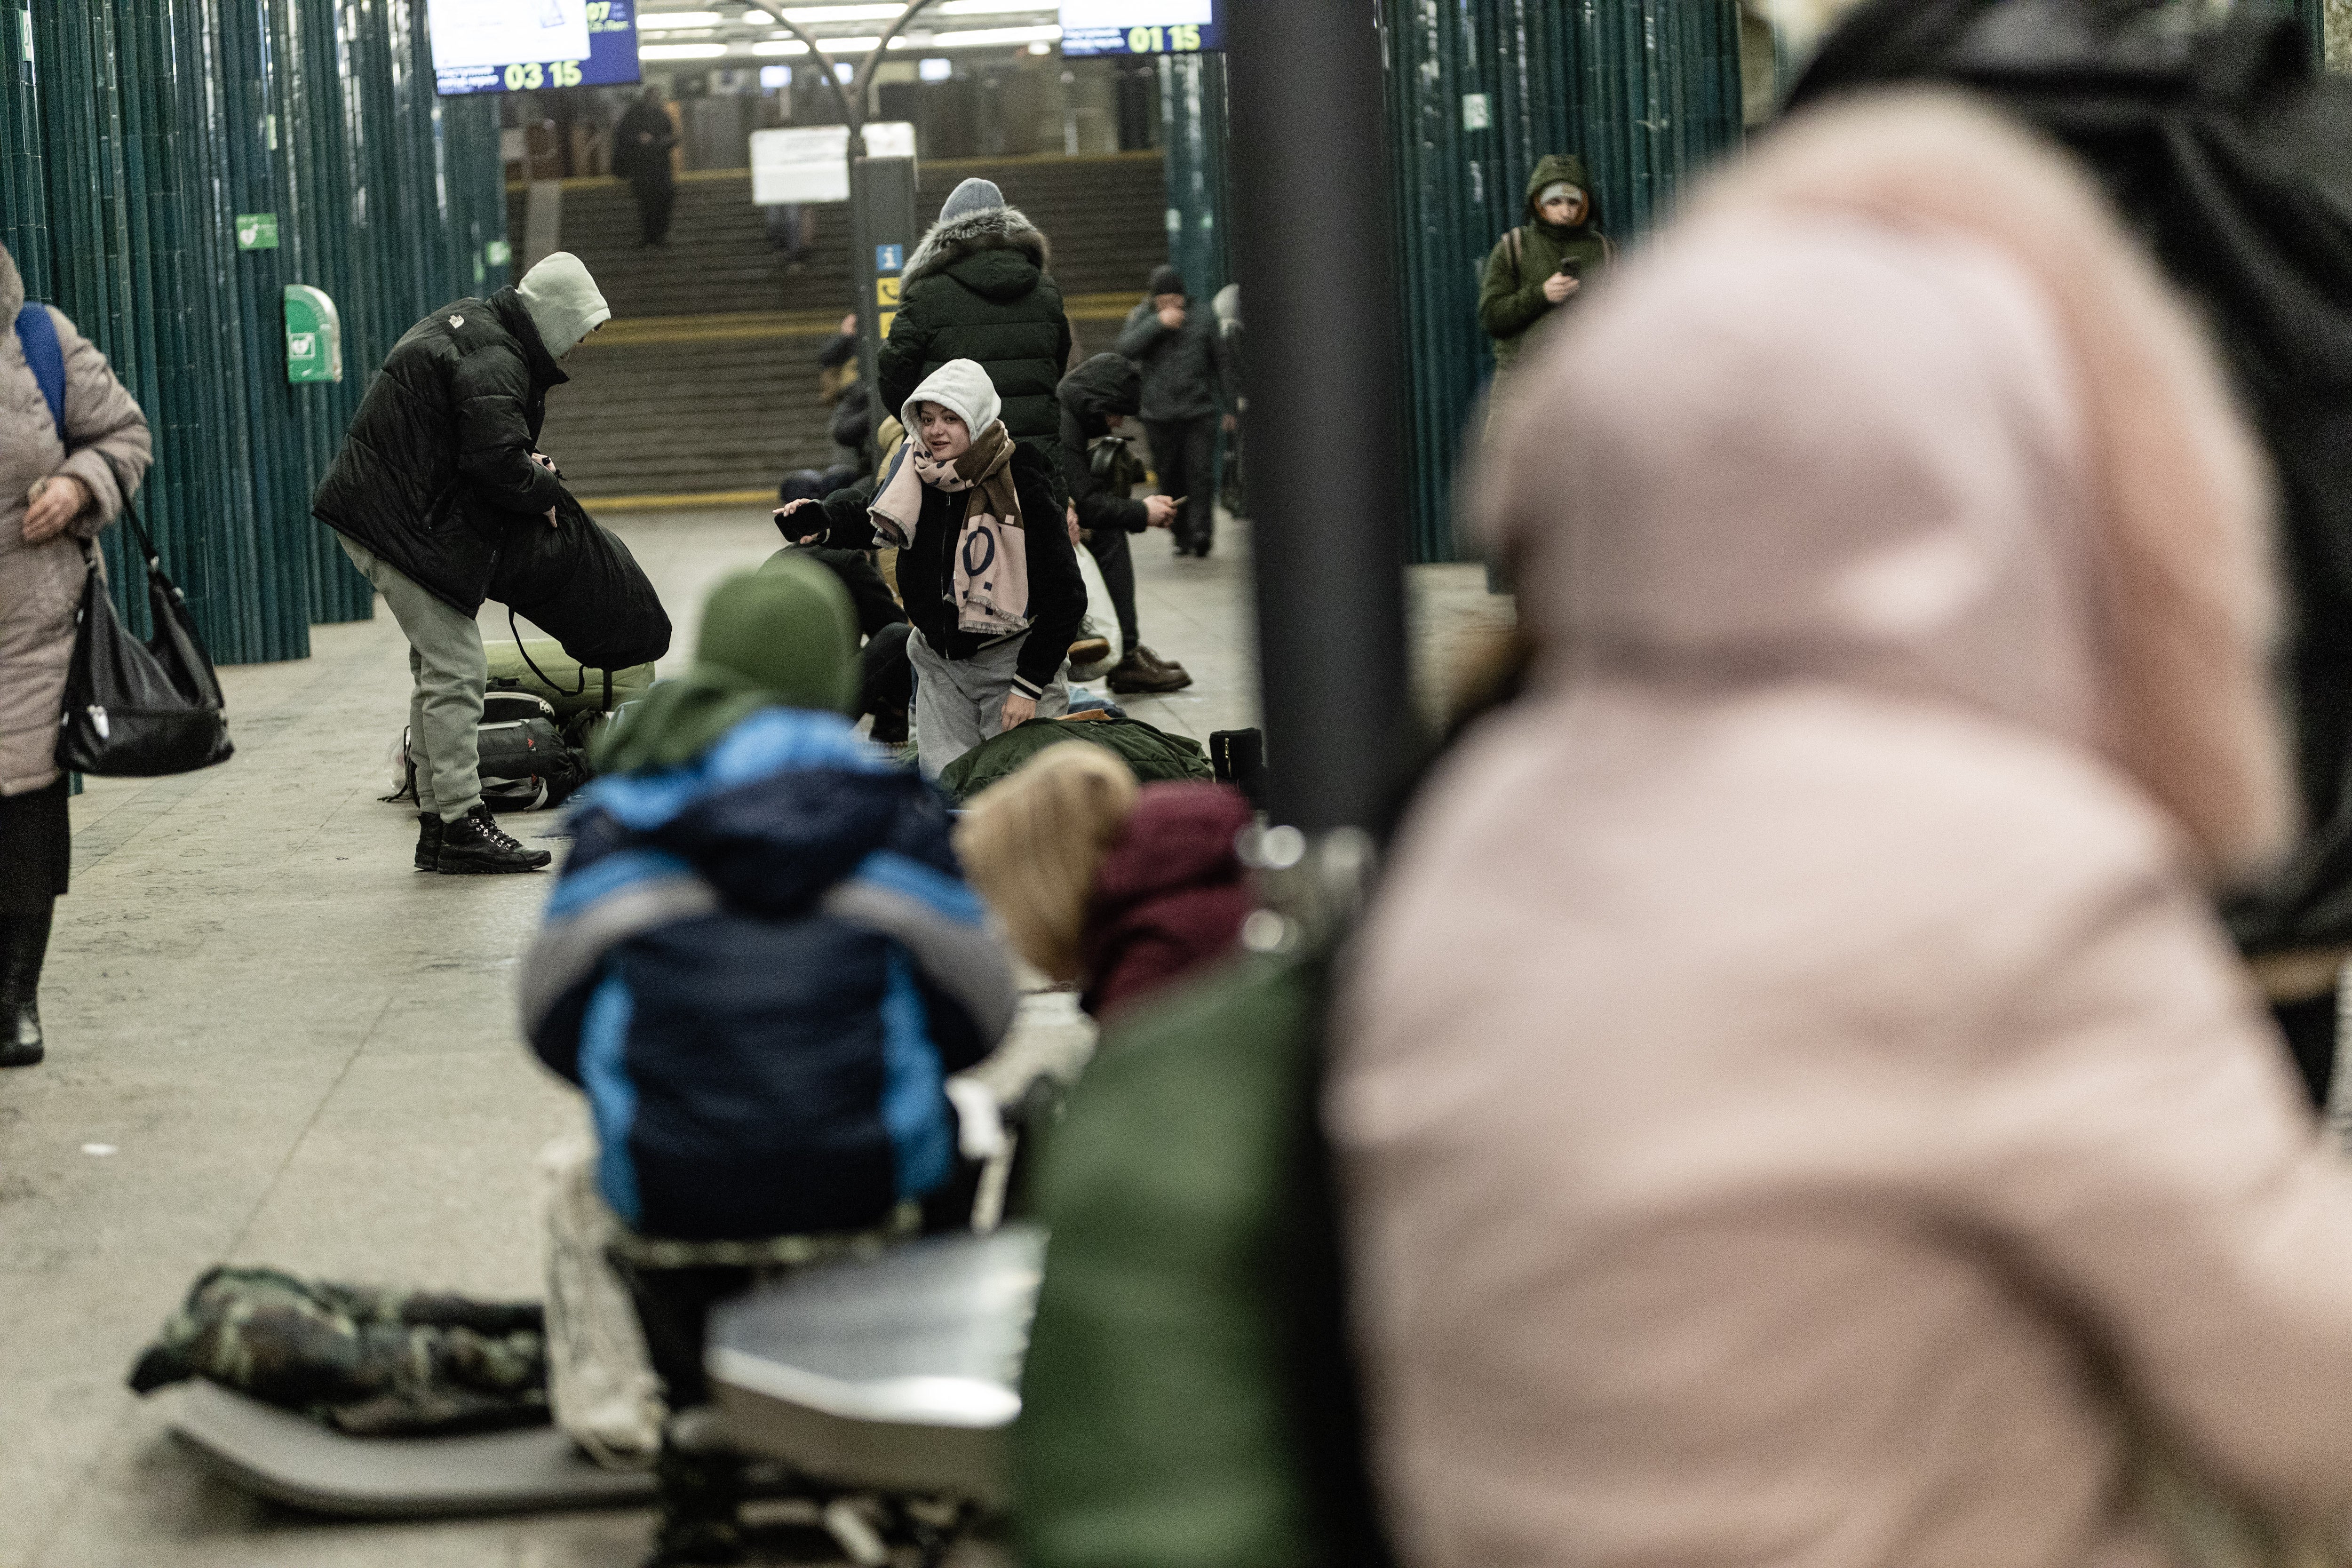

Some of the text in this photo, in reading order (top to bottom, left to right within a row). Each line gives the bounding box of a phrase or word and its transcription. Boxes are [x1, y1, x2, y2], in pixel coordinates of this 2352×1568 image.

[1128, 26, 1163, 53] 01
[1168, 24, 1201, 51] 15
[504, 62, 544, 91] 03
[548, 60, 583, 88] 15
